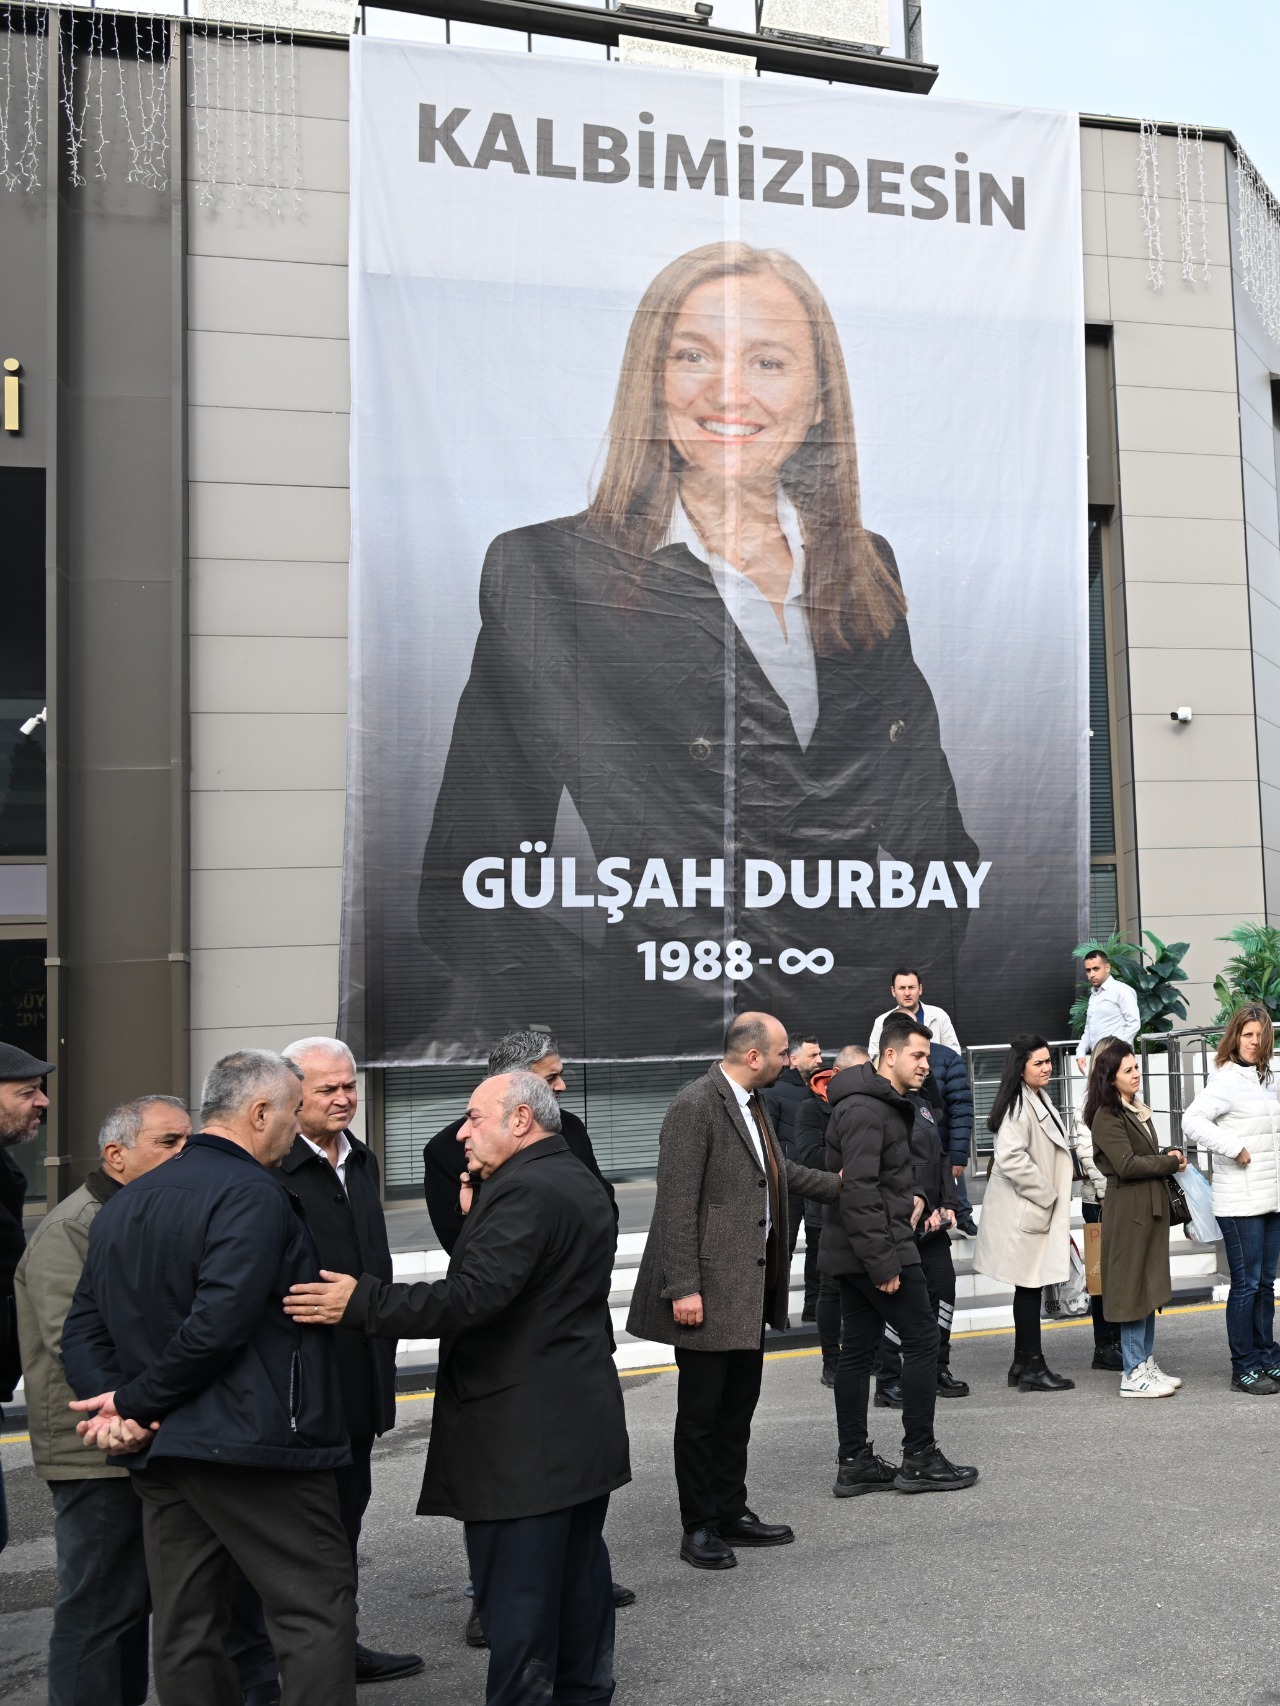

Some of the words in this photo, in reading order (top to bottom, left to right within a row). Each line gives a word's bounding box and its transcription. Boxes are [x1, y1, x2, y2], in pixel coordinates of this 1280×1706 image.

[418, 102, 1026, 231] KALBİMİZDESİN
[461, 840, 725, 924] GÜLŞAH
[744, 859, 993, 909] DURBAY
